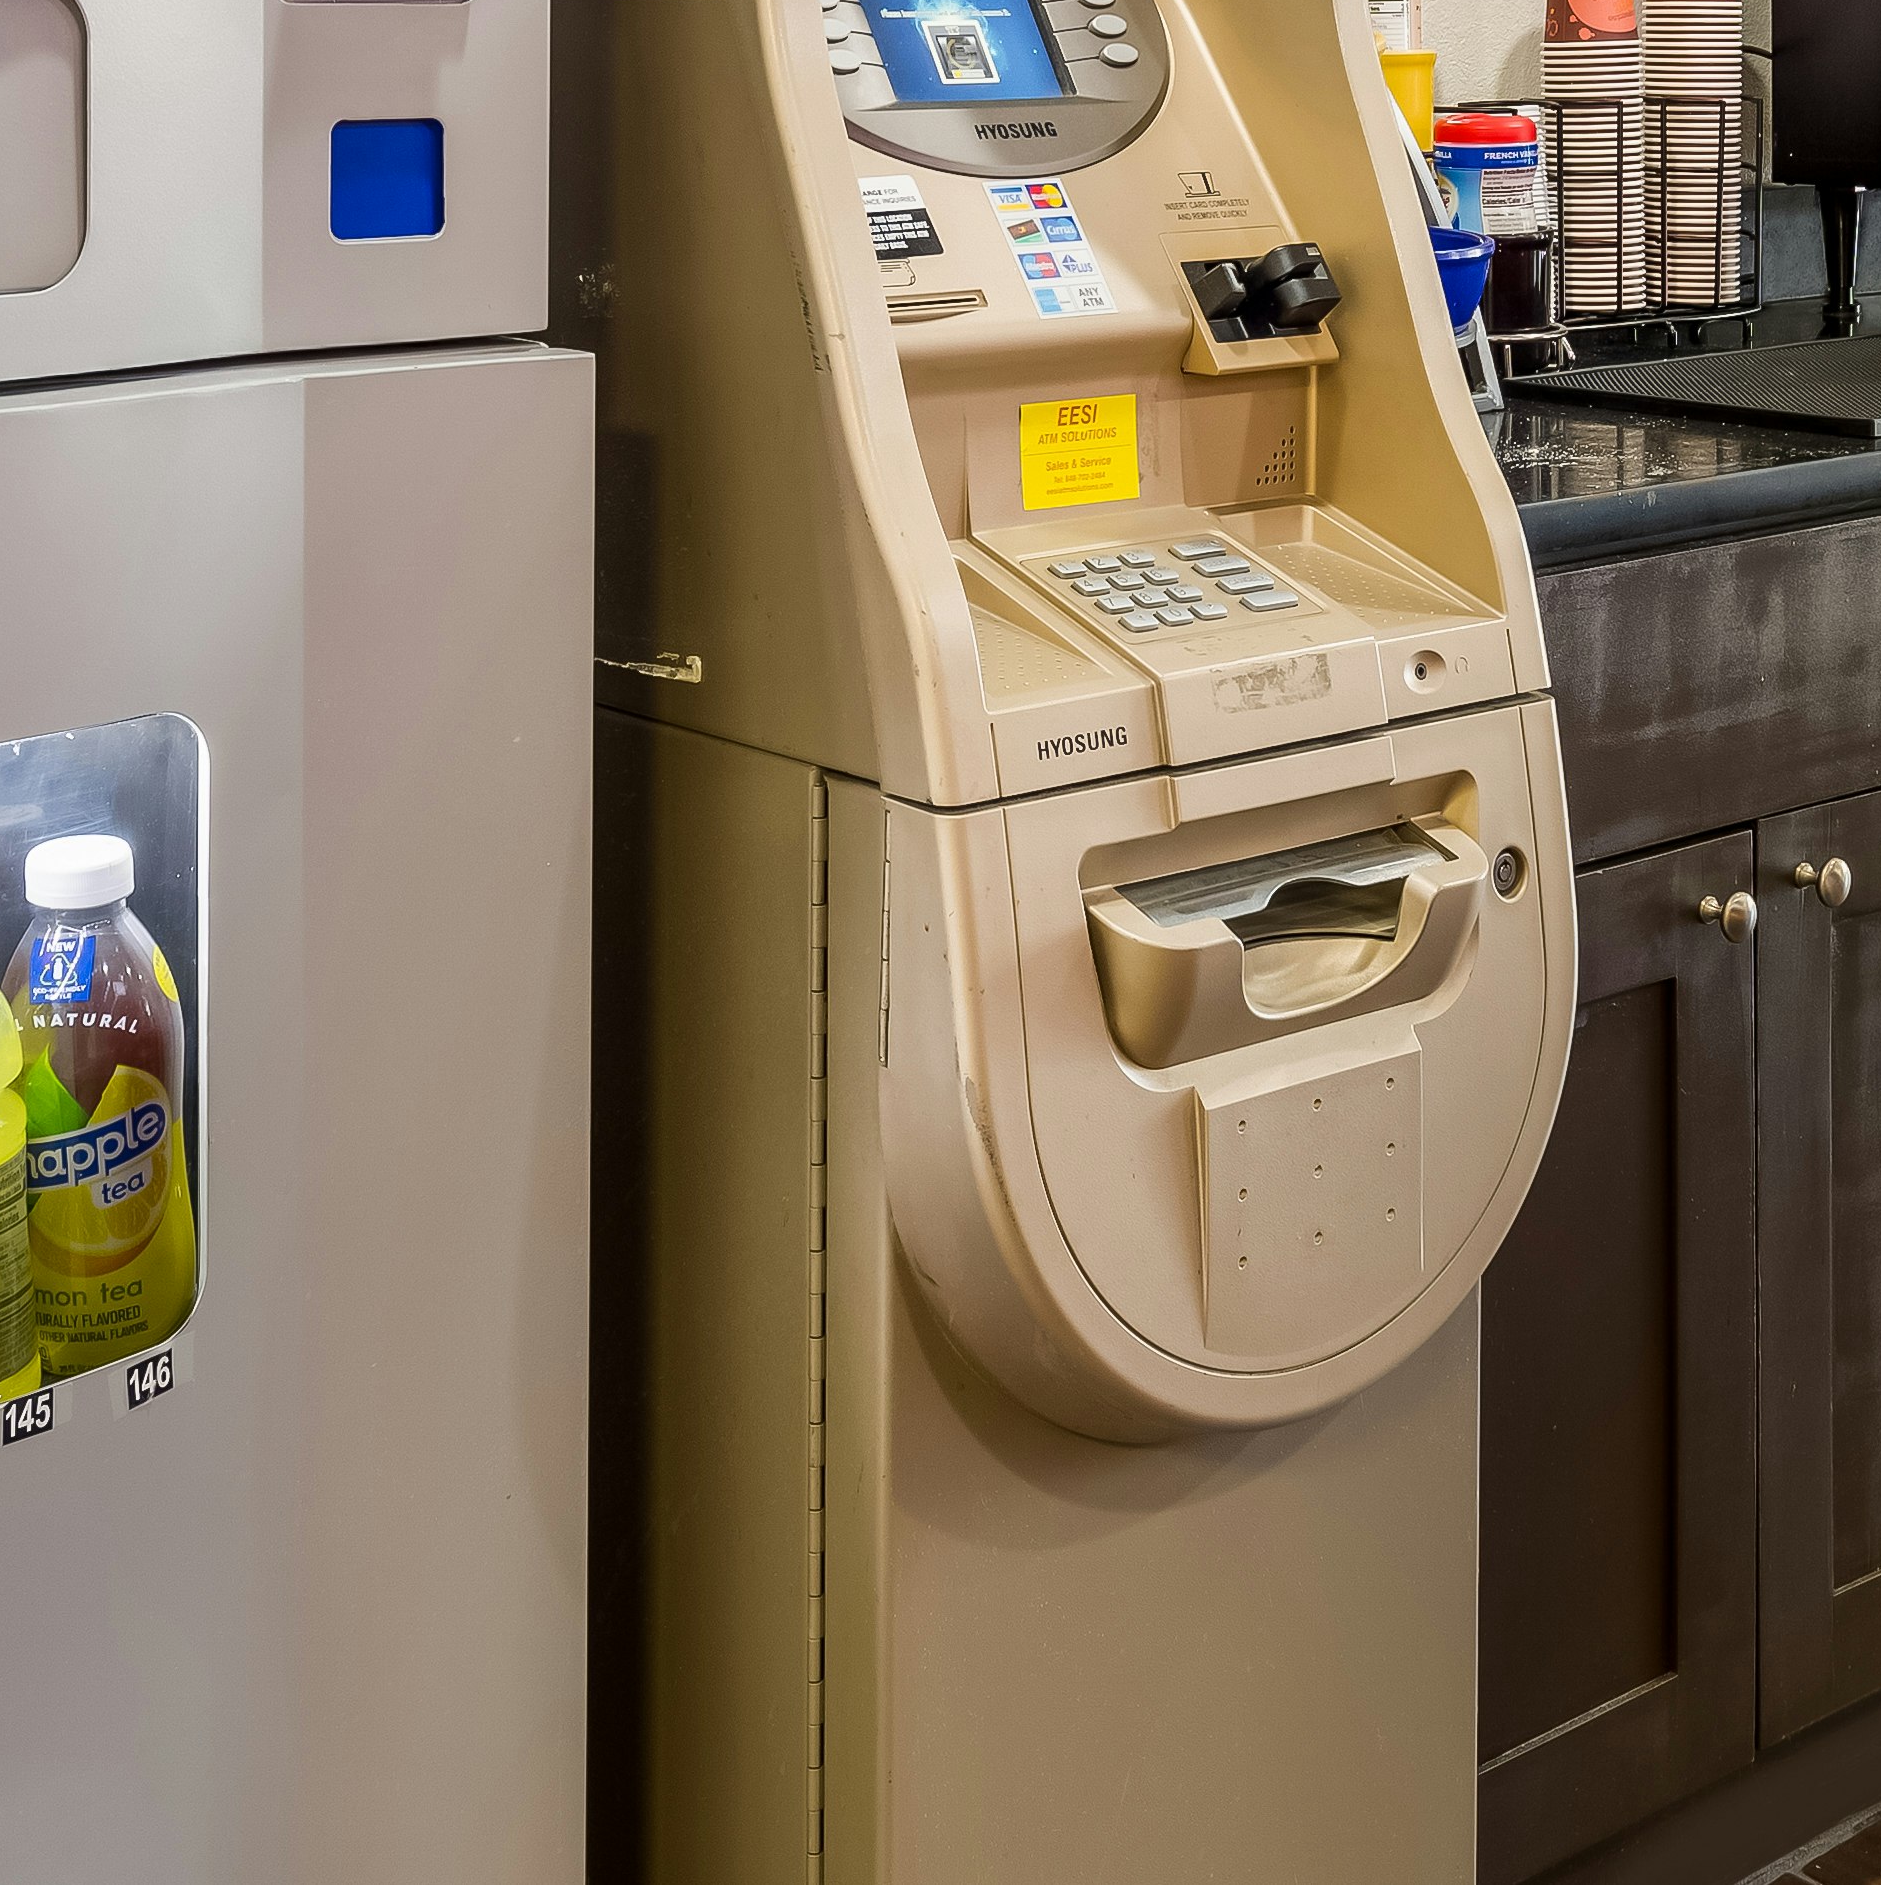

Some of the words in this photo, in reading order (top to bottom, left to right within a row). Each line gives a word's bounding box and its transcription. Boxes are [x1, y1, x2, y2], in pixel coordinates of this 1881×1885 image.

[974, 120, 1058, 141] HYOSUNG
[1484, 151, 1519, 160] FRENCH
[998, 194, 1023, 204] VISA
[1163, 202, 1187, 211] INSERT
[1188, 201, 1208, 209] CARD
[1208, 198, 1250, 208] COMPLETELY
[1177, 212, 1192, 221] AND
[1192, 211, 1221, 220] REMOVE
[1220, 209, 1248, 218] QUICKLY
[1070, 262, 1093, 273] PLUS
[1078, 287, 1100, 297] ANY
[1083, 296, 1105, 307] ATM
[1057, 403, 1098, 427] EESI
[1037, 433, 1058, 445] ATM
[1061, 427, 1117, 443] SOLUTIONS
[1046, 460, 1069, 472] Sales
[1071, 458, 1077, 469] &
[1080, 457, 1112, 469] Service
[1036, 725, 1129, 761] HYOSUNG
[45, 940, 76, 953] NEW
[32, 1012, 138, 1035] NATURAL
[101, 1171, 146, 1205] tea
[35, 1287, 88, 1307] mon
[100, 1279, 143, 1305] tea
[81, 1304, 142, 1328] FLAVORED
[39, 1329, 66, 1343] OTHER
[67, 1329, 108, 1343] NATURAL
[109, 1319, 149, 1340] FLAVORS
[128, 1356, 171, 1402] 146
[6, 1394, 51, 1435] 145
